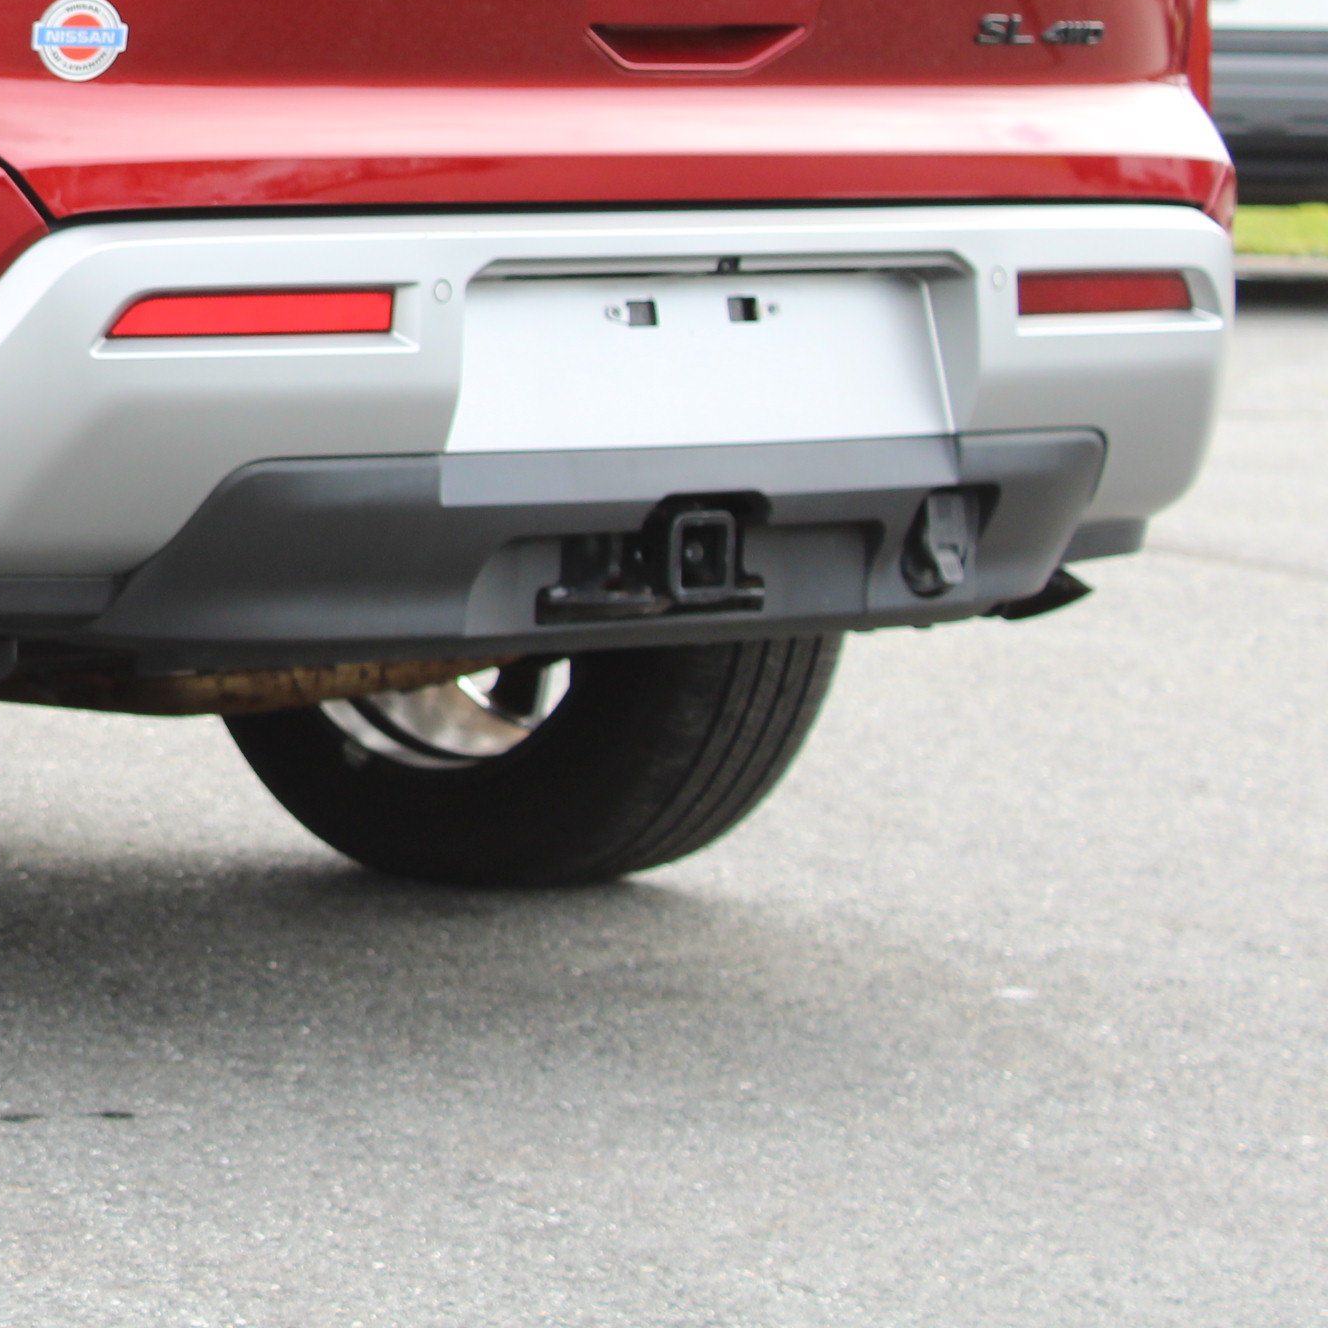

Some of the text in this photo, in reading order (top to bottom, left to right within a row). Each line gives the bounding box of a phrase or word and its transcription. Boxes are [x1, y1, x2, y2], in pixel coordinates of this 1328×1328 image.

[45, 30, 116, 44] NISSAN
[975, 12, 1105, 45] SL 4WD
